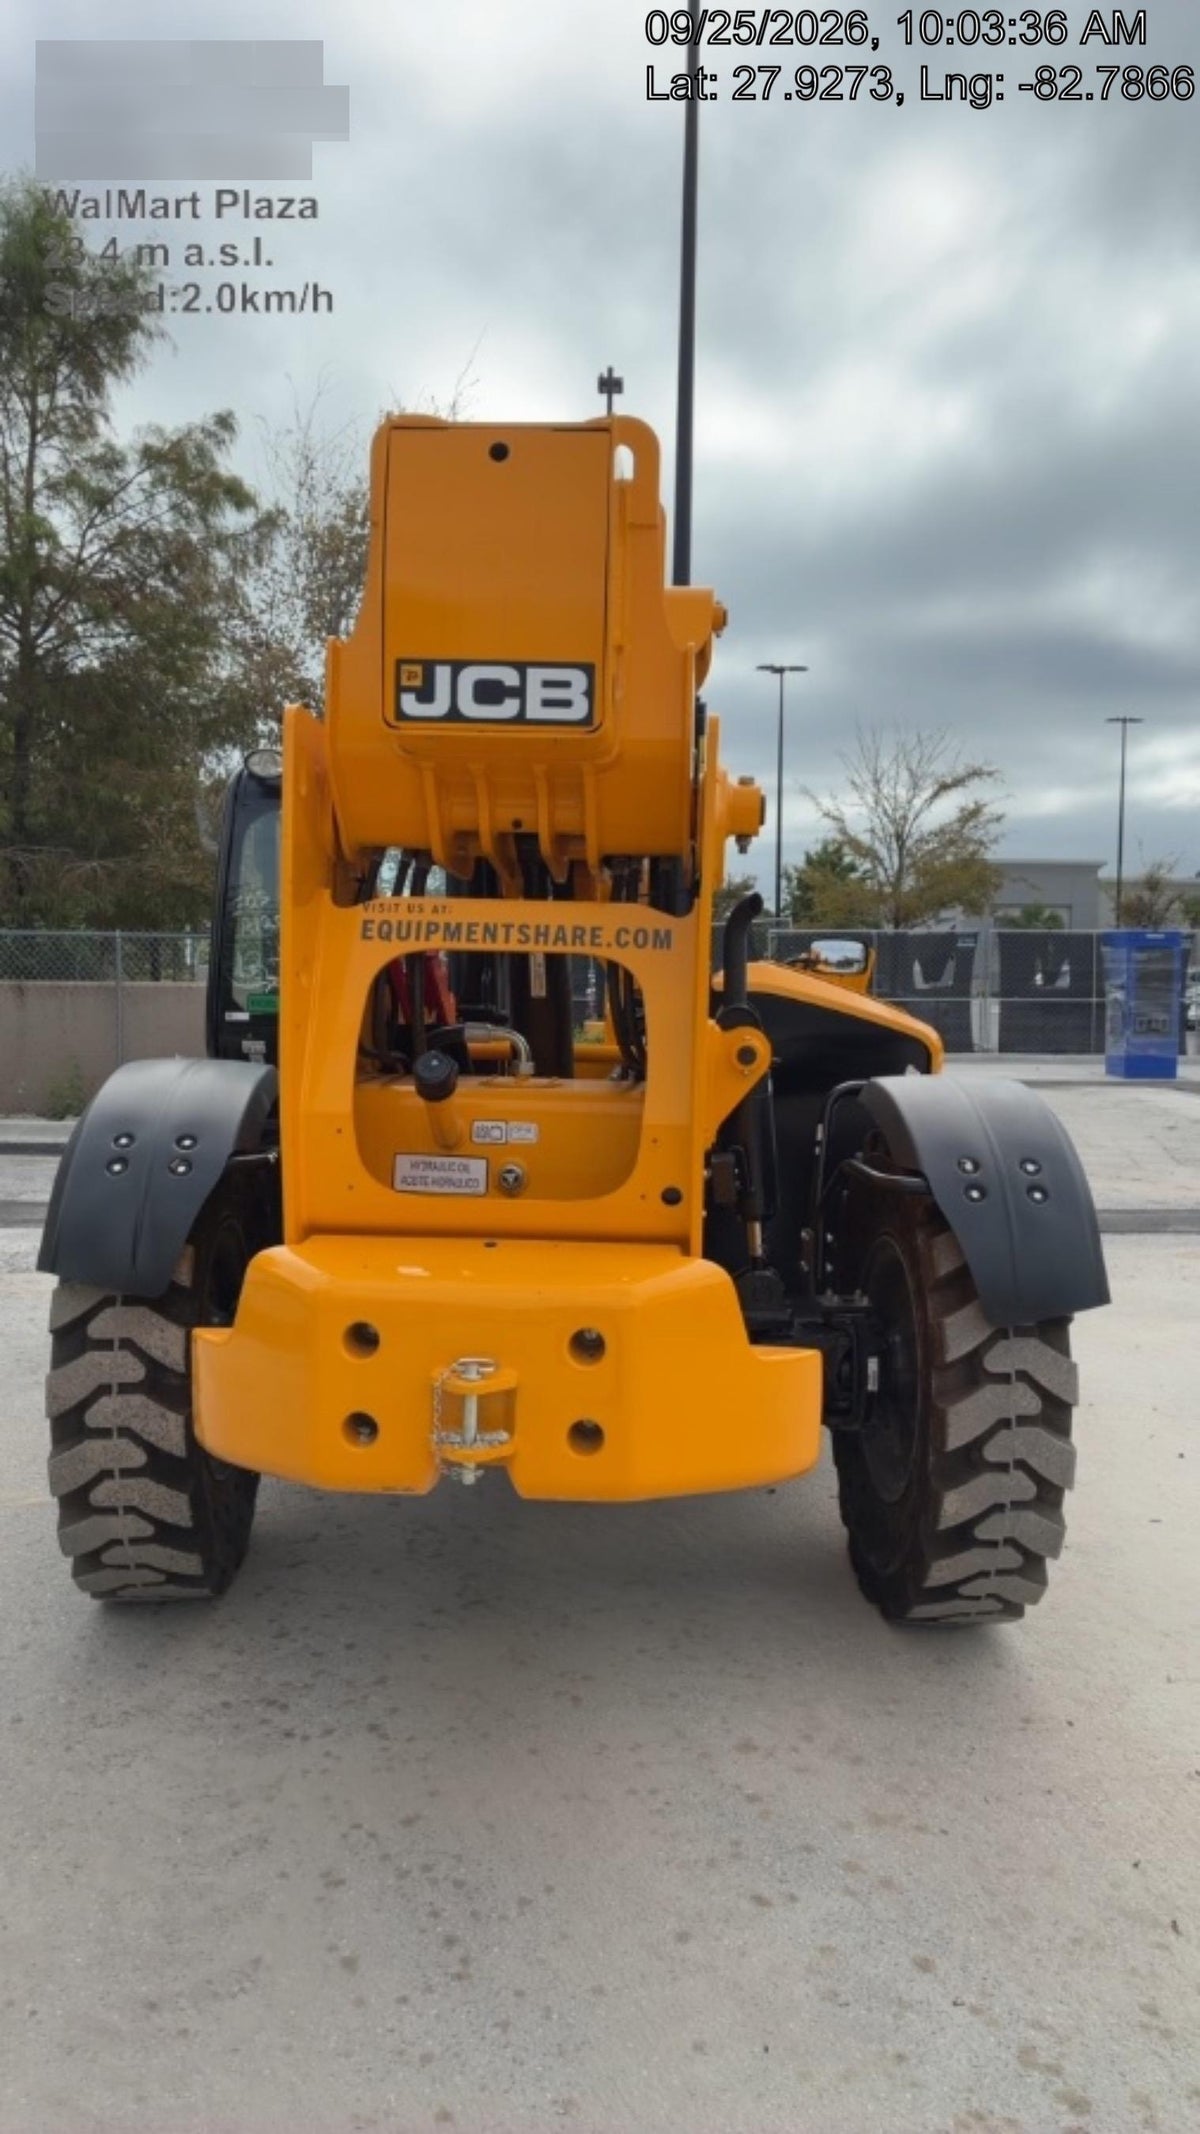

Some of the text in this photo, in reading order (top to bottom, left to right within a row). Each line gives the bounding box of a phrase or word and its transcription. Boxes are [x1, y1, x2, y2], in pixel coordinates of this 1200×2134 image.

[400, 665, 590, 721] JCB
[362, 902, 400, 914] VISIT
[407, 904, 424, 914] US
[360, 919, 673, 950] EQUIPMENTSHARE.COM
